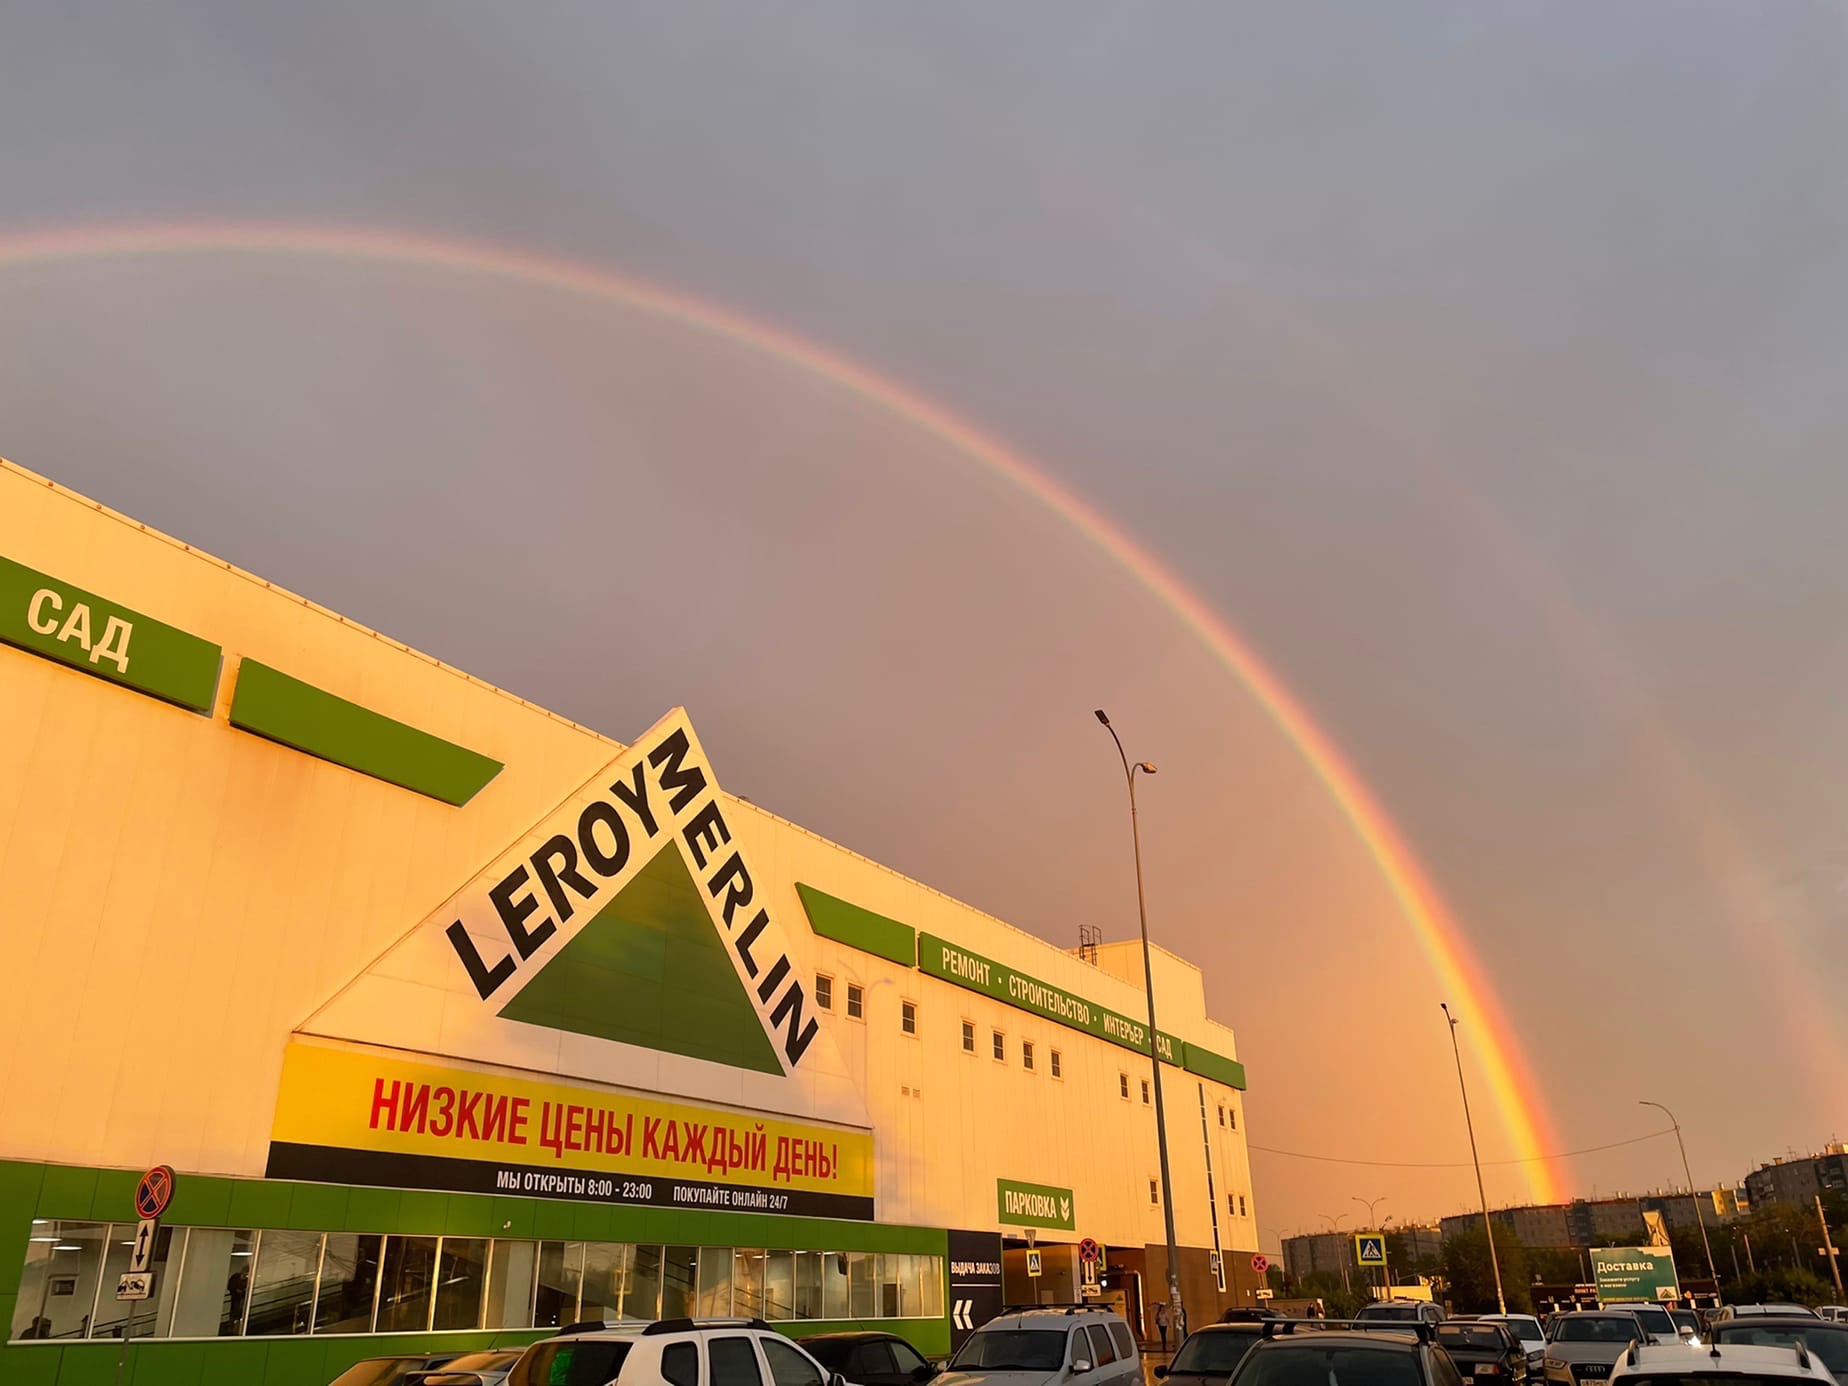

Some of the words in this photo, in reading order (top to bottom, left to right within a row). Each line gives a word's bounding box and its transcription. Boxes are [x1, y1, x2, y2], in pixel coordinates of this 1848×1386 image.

[27, 588, 134, 674] САД
[445, 760, 660, 1002] LEROY
[646, 726, 820, 1068] MERLIN
[942, 946, 991, 986] РЕМОНТ
[1008, 974, 1090, 1026] СТРОИТЕЛЬСТВО
[1103, 1012, 1144, 1046] ИНТЕРЬЕР
[1155, 1034, 1173, 1060] САД
[369, 1077, 531, 1145] НИЗКИЕ
[539, 1101, 634, 1159] ЦЕНЫ
[642, 1115, 767, 1176] КАЖДЫЙ
[773, 1135, 838, 1183] ДЕНЬ!
[496, 1170, 521, 1190] МЫ
[524, 1172, 585, 1195] ОТКРЫТЫ
[587, 1178, 613, 1197] 8:00
[622, 1181, 652, 1200] 23:00
[673, 1186, 730, 1205] ПОКУПАЙТЕ
[732, 1190, 768, 1208] ОНЛАЙН
[769, 1194, 788, 1209] 24/7
[1005, 1190, 1057, 1219] ПАРКОВКА
[951, 1261, 975, 1276] ВЫДАЧА
[1597, 1261, 1654, 1274] Доставка
